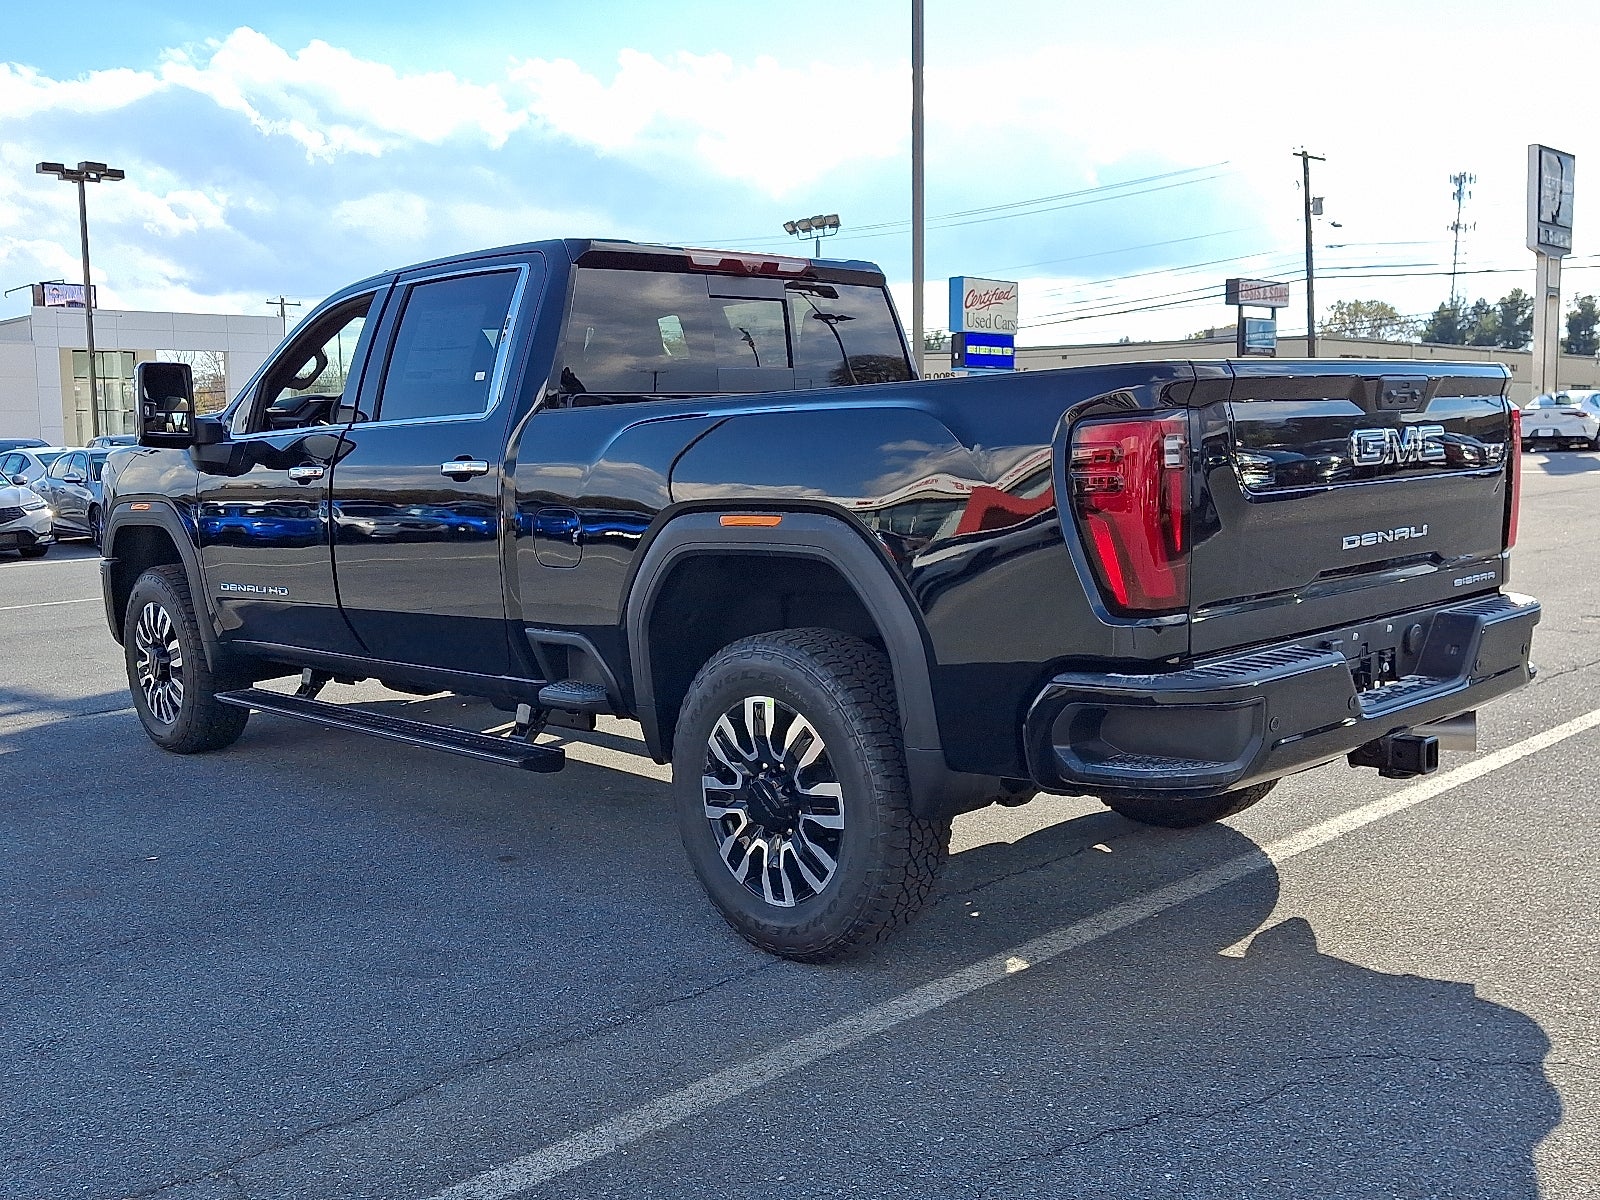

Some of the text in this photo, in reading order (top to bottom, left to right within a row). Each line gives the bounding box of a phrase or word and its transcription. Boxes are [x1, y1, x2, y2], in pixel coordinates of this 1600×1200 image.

[965, 286, 1016, 310] Certified
[966, 312, 1016, 330] Used Cars
[1350, 425, 1446, 466] GMC
[1342, 524, 1429, 550] DENALI
[220, 583, 289, 596] DENALI HD
[1454, 571, 1496, 587] SIERRA
